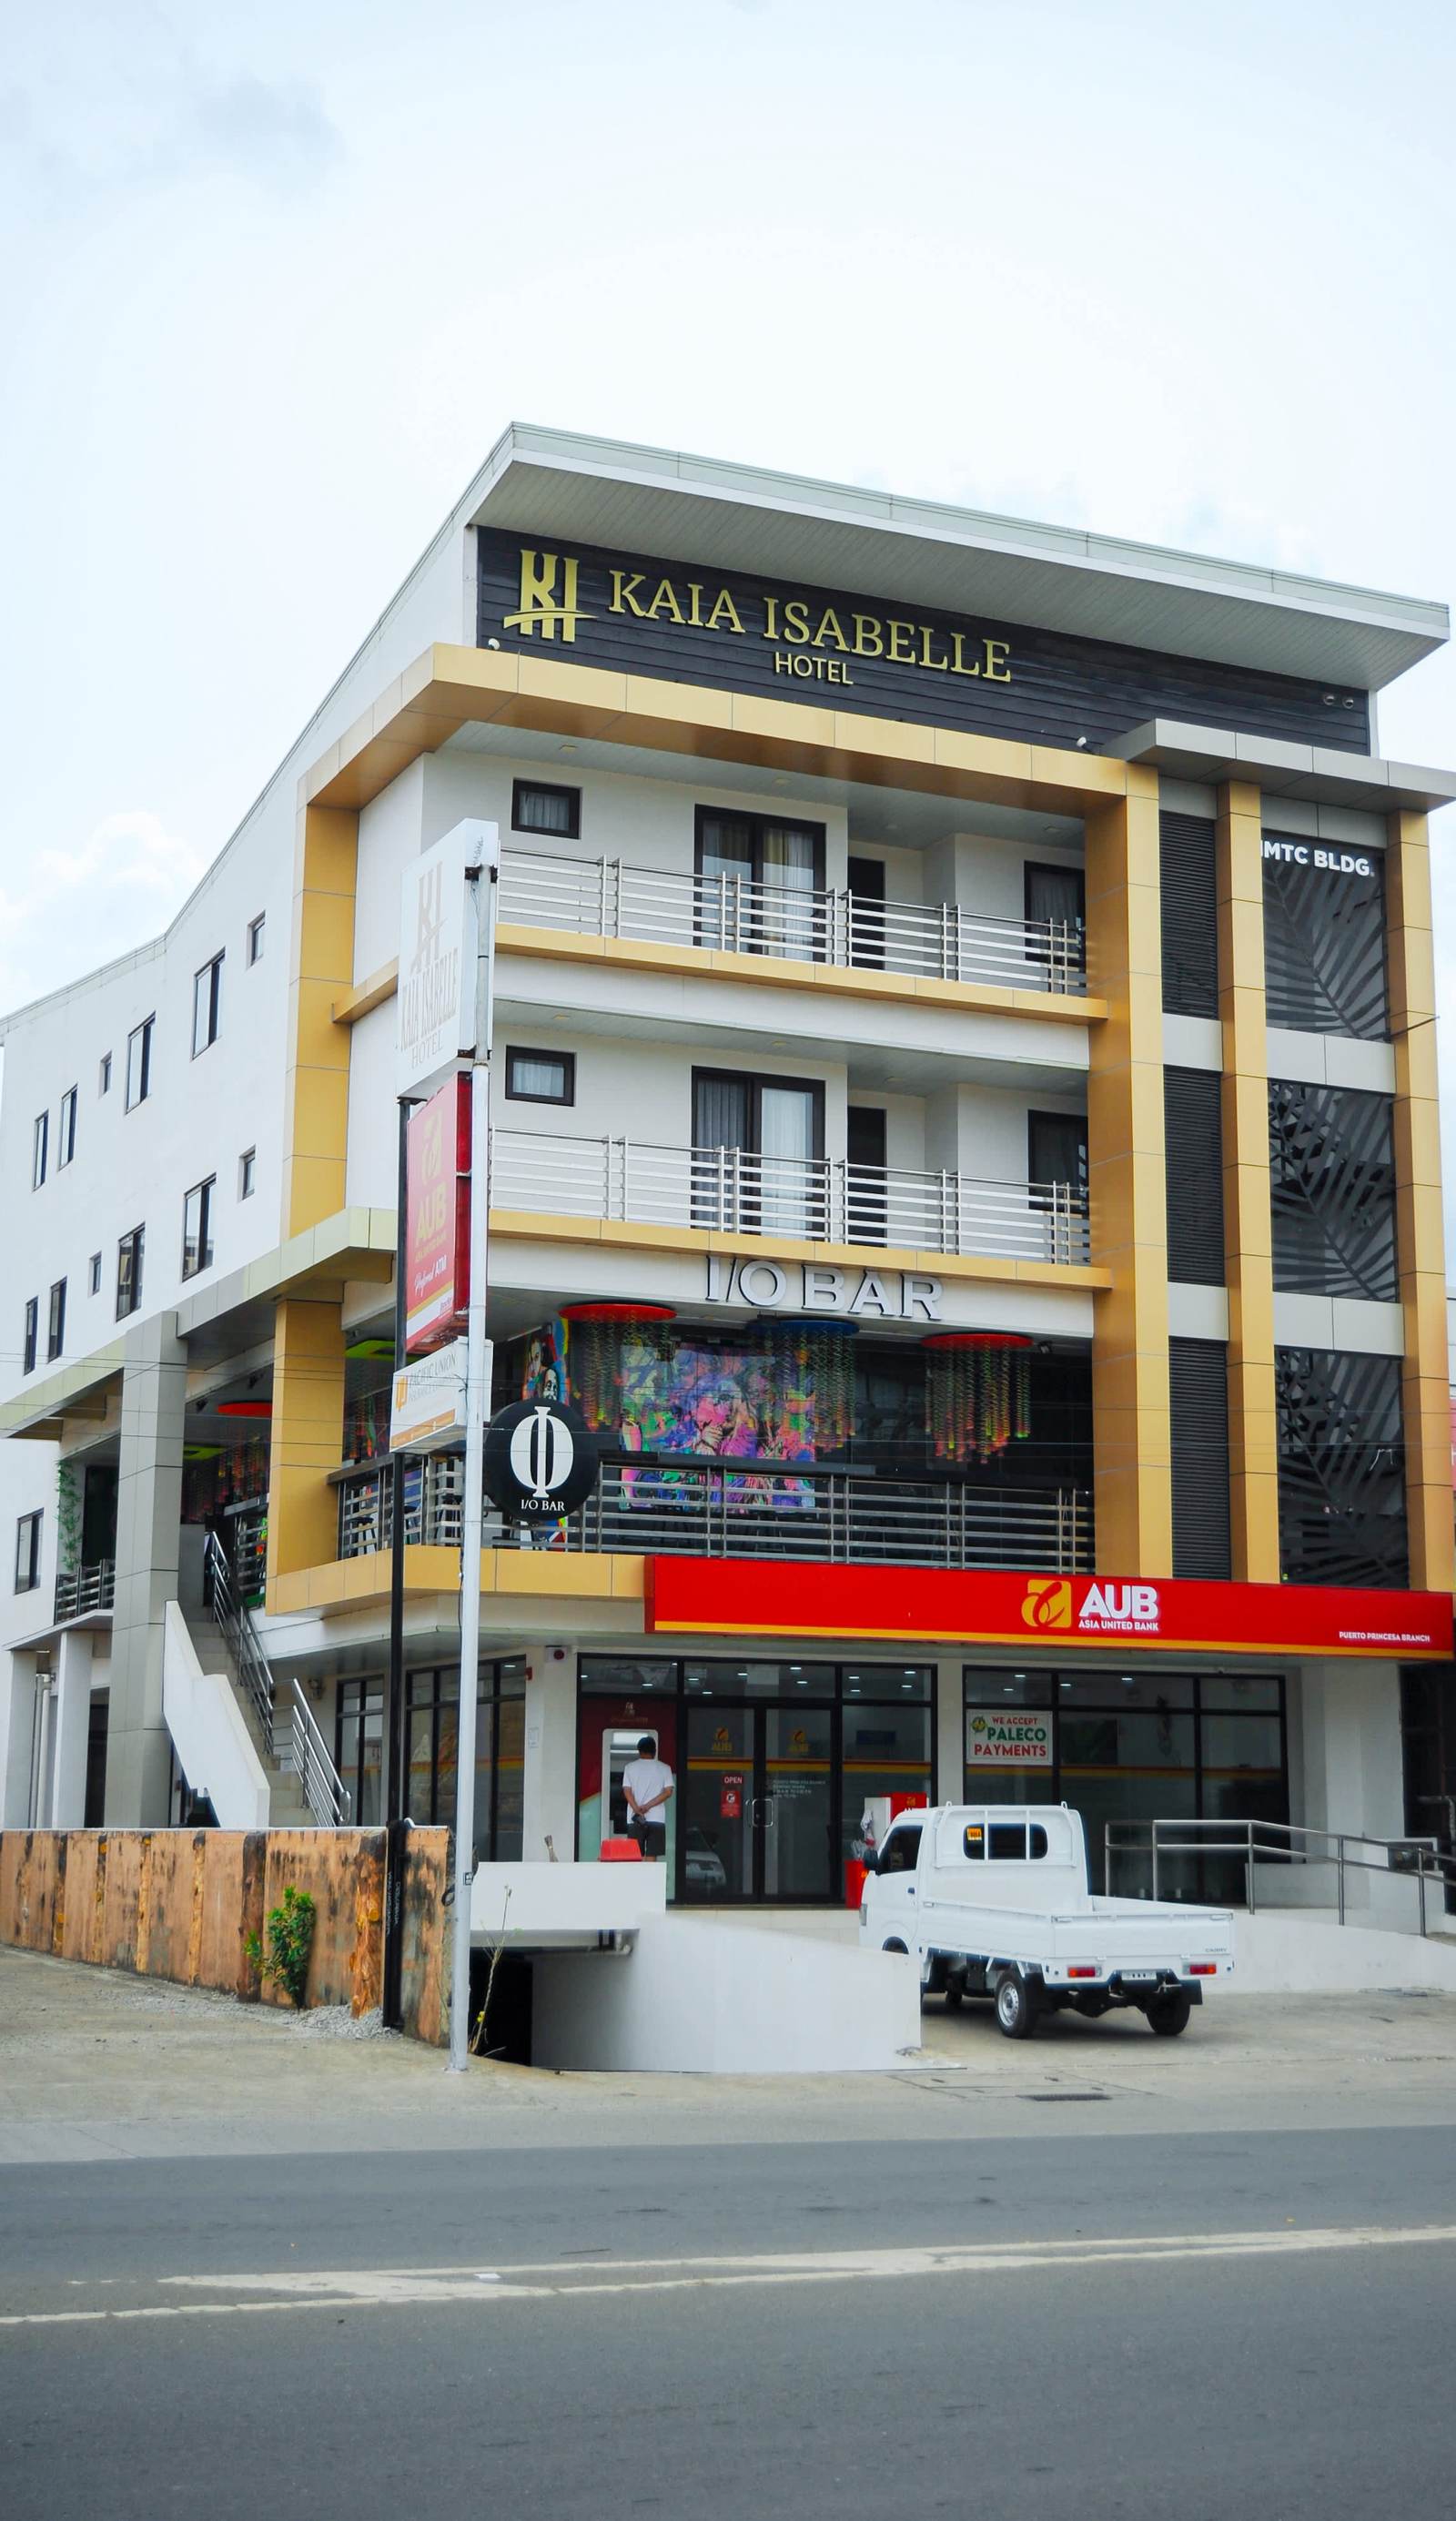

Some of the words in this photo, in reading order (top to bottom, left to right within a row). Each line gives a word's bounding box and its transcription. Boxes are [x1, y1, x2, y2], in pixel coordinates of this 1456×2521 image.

[608, 570, 746, 633] KAIA
[763, 597, 1012, 682] ISABELLE
[774, 652, 854, 685] HOTEL
[410, 1028, 444, 1069] HOTEL
[416, 1181, 447, 1249] AUB
[800, 1263, 944, 1321] BAR
[521, 1499, 539, 1510] I/O
[541, 1500, 565, 1512] BAR
[1078, 1583, 1158, 1620] AUB
[1078, 1620, 1100, 1629] ASIA
[1101, 1620, 1133, 1631] UNITED
[1134, 1622, 1158, 1632] BANK
[1339, 1631, 1367, 1640] PUERTO
[1367, 1632, 1401, 1642] PRINCESA
[1401, 1634, 1431, 1644] BRANCH
[991, 1716, 1006, 1725] WE
[1006, 1716, 1038, 1726] ACCEPT
[987, 1727, 1046, 1742] PALECO
[974, 1744, 1046, 1757] PAYMENTS
[724, 1776, 743, 1785] OPEN
